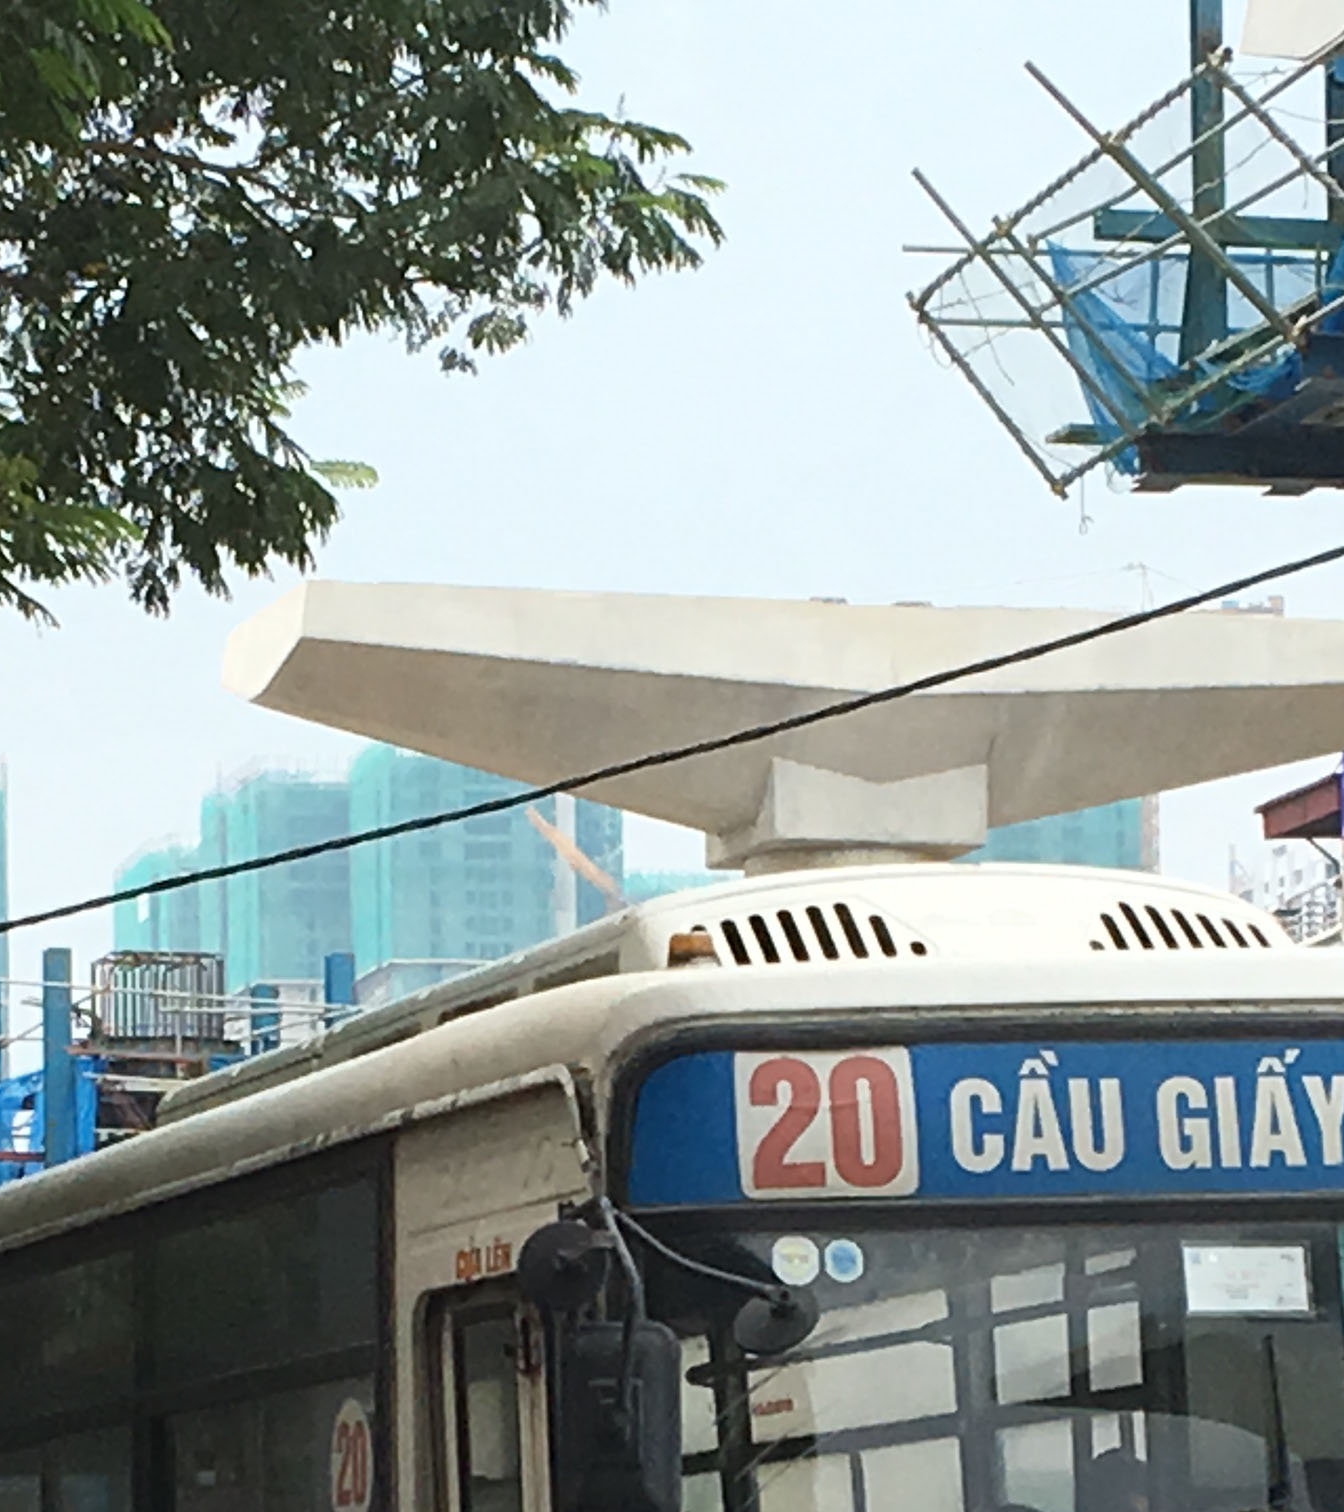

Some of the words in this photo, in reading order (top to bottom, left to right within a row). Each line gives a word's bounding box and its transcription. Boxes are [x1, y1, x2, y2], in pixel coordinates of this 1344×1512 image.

[749, 1055, 903, 1189] 20
[950, 1050, 1126, 1174] CẦU
[336, 1420, 368, 1506] 20
